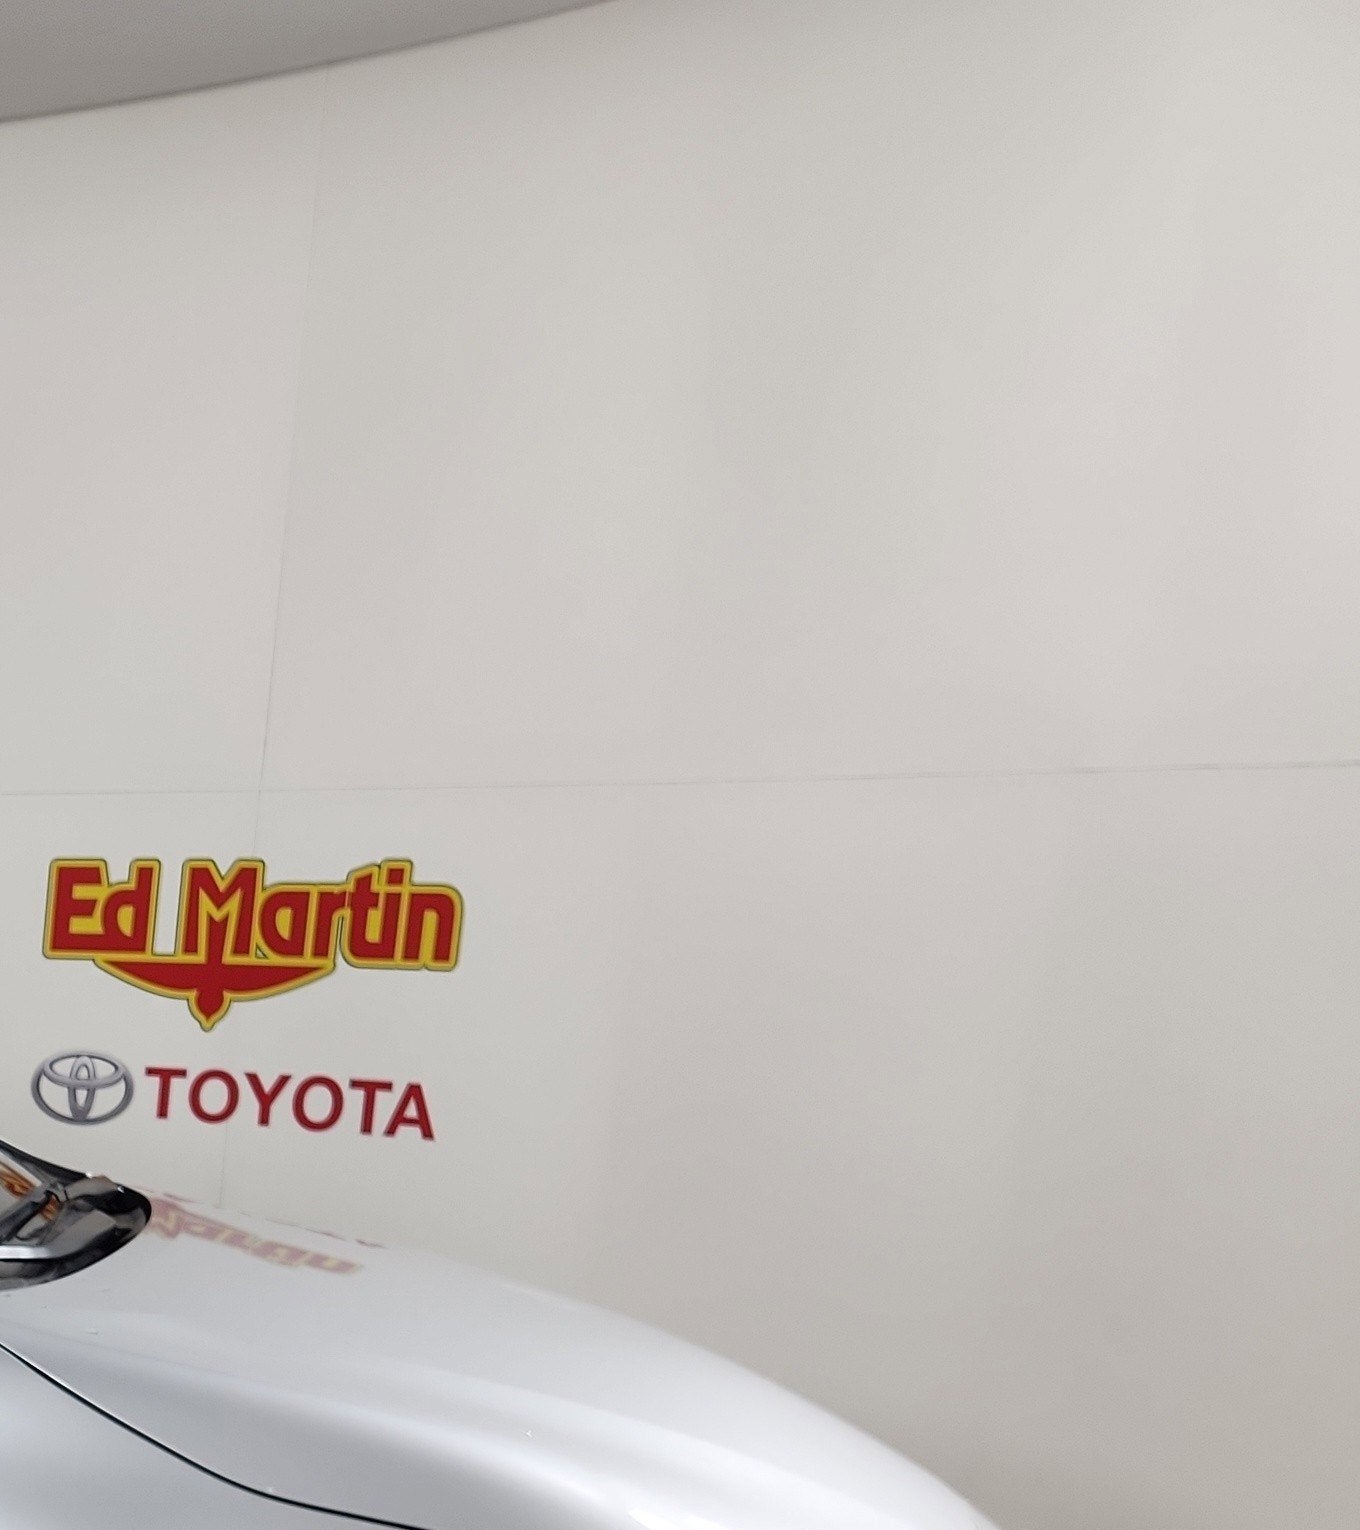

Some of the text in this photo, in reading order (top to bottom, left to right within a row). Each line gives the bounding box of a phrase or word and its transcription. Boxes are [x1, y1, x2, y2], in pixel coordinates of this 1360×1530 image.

[48, 863, 460, 964] Ed Martin
[143, 1065, 436, 1142] TOYOTA
